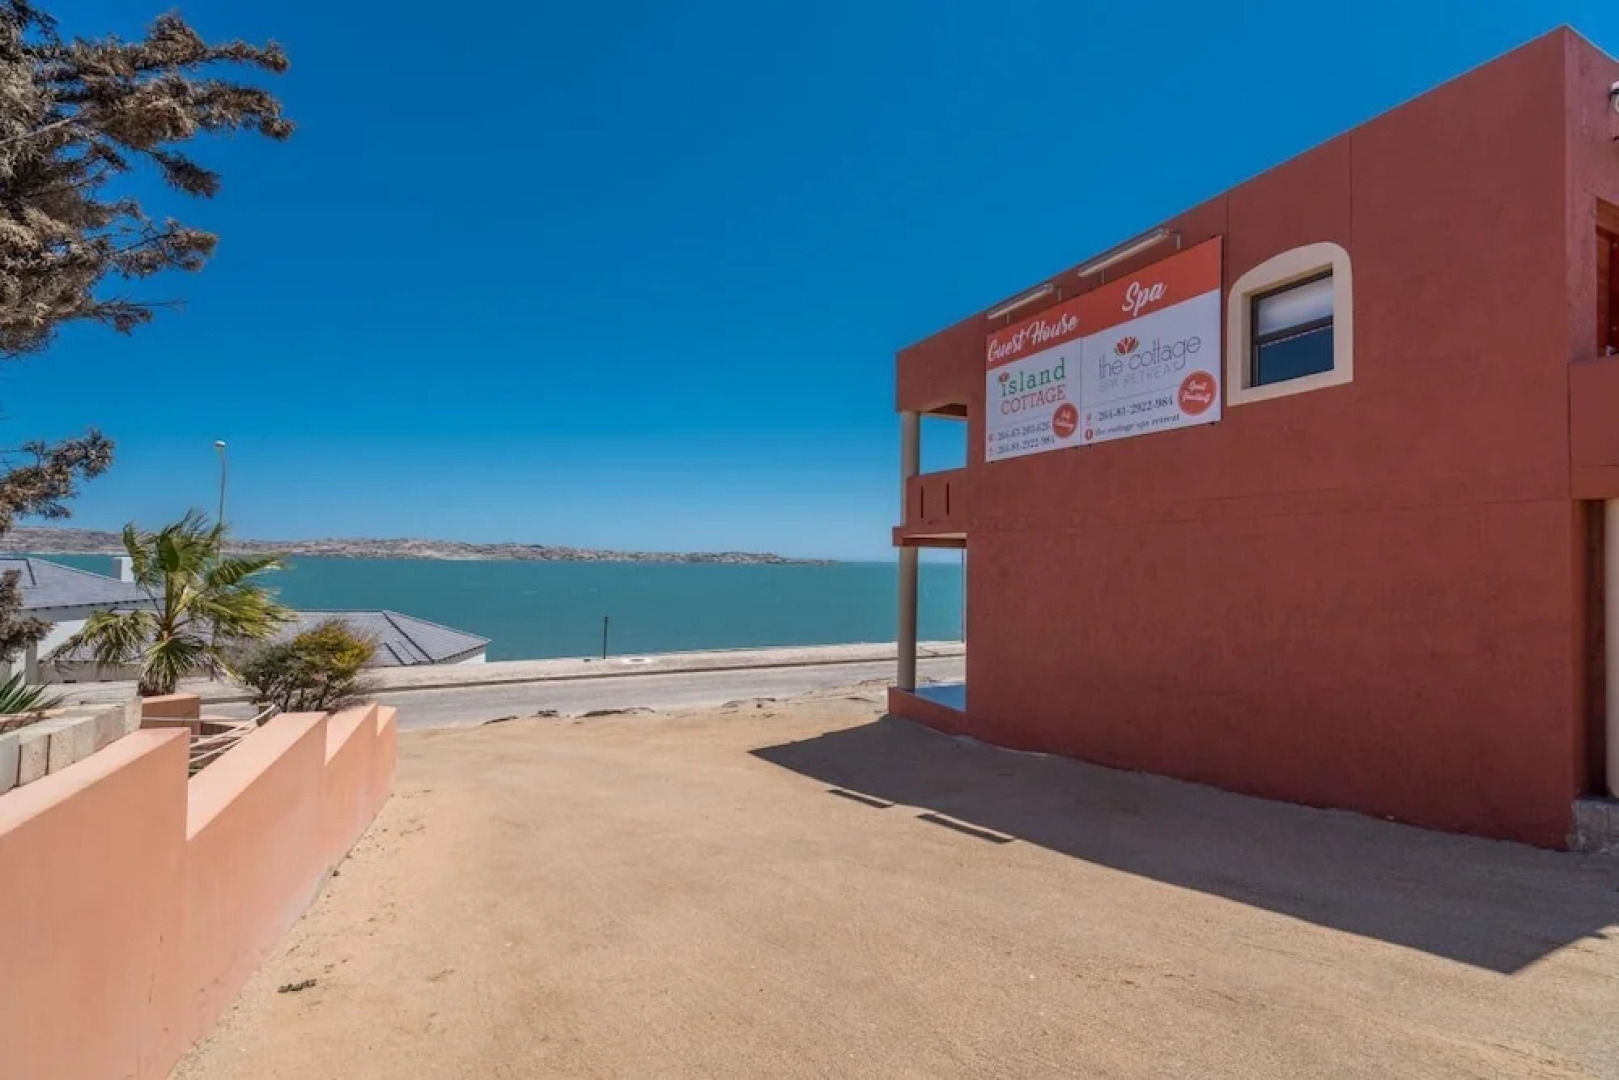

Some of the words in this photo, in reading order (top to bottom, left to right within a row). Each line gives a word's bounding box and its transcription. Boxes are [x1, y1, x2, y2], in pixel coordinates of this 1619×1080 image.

[1121, 281, 1167, 317] Spa
[987, 328, 1026, 362] Guest
[1026, 313, 1079, 345] House
[1098, 350, 1123, 379] the
[1128, 336, 1202, 371] cottage
[999, 356, 1066, 397] island
[1001, 384, 1066, 415] COTTAGE
